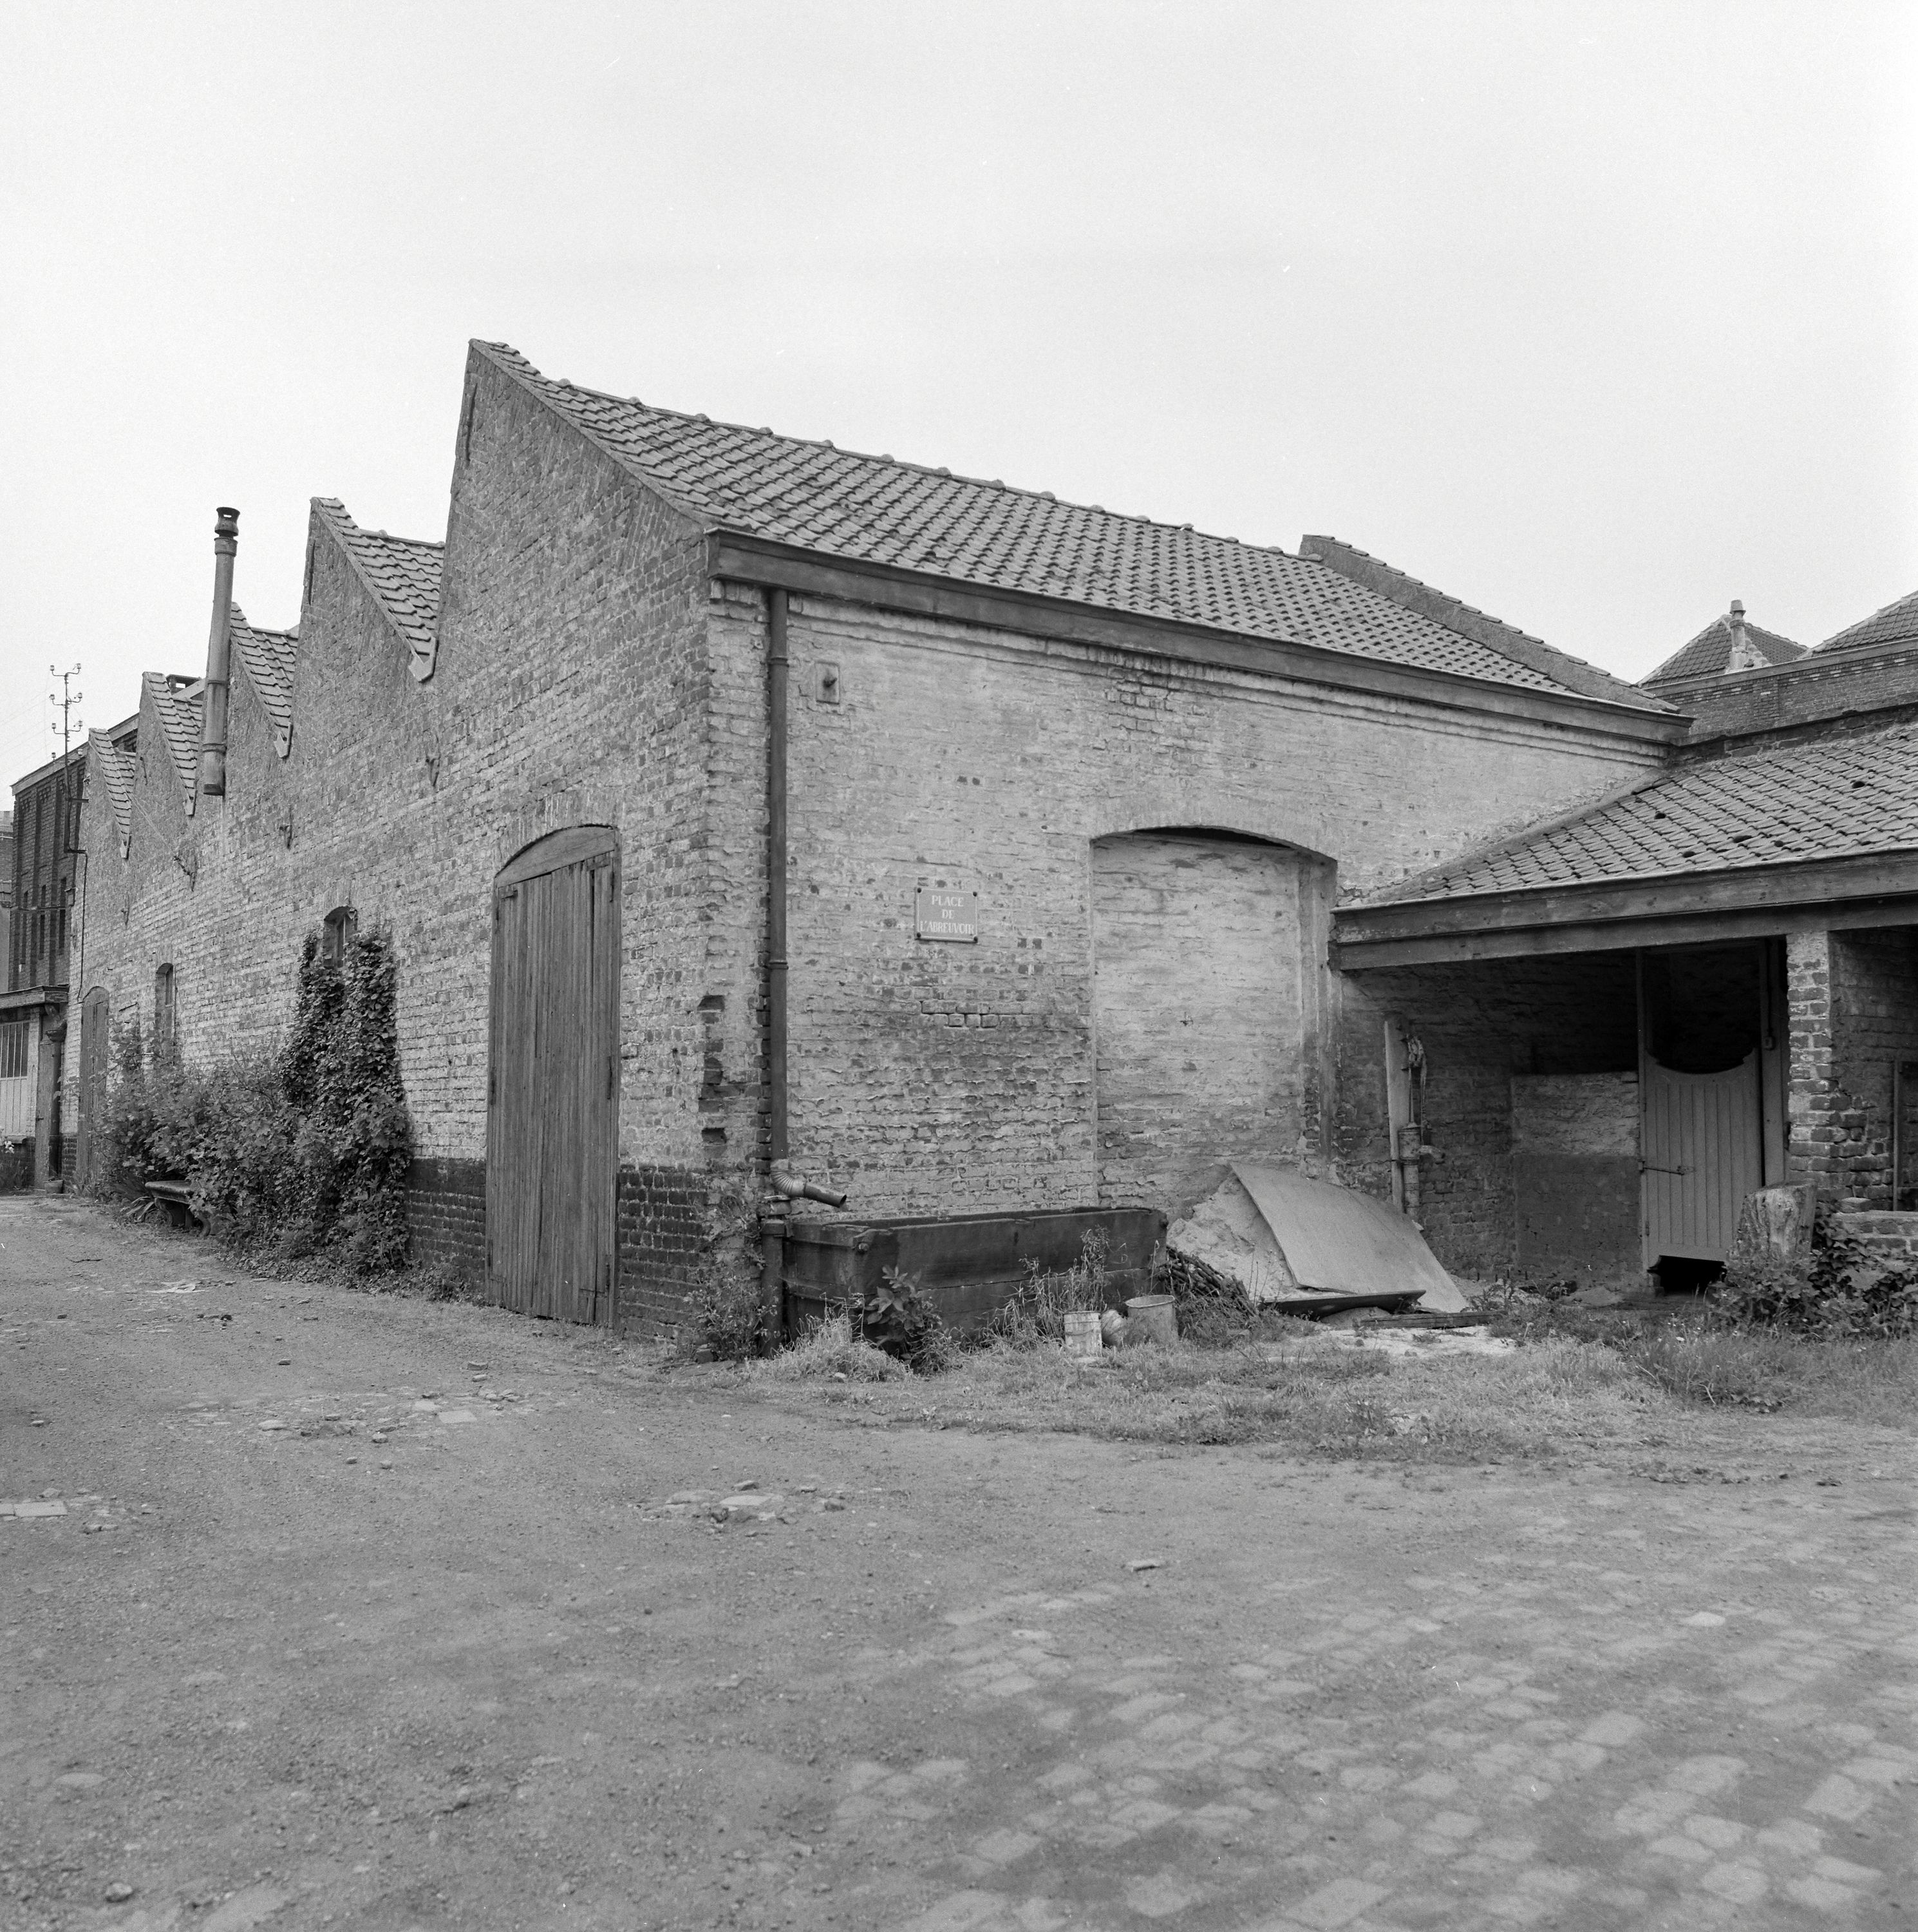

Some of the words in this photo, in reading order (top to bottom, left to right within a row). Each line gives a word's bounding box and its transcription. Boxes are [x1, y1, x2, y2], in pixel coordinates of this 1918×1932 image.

[932, 895, 964, 907] PLACE
[942, 909, 954, 919] DE
[920, 920, 974, 934] L'ABREUVOIR
